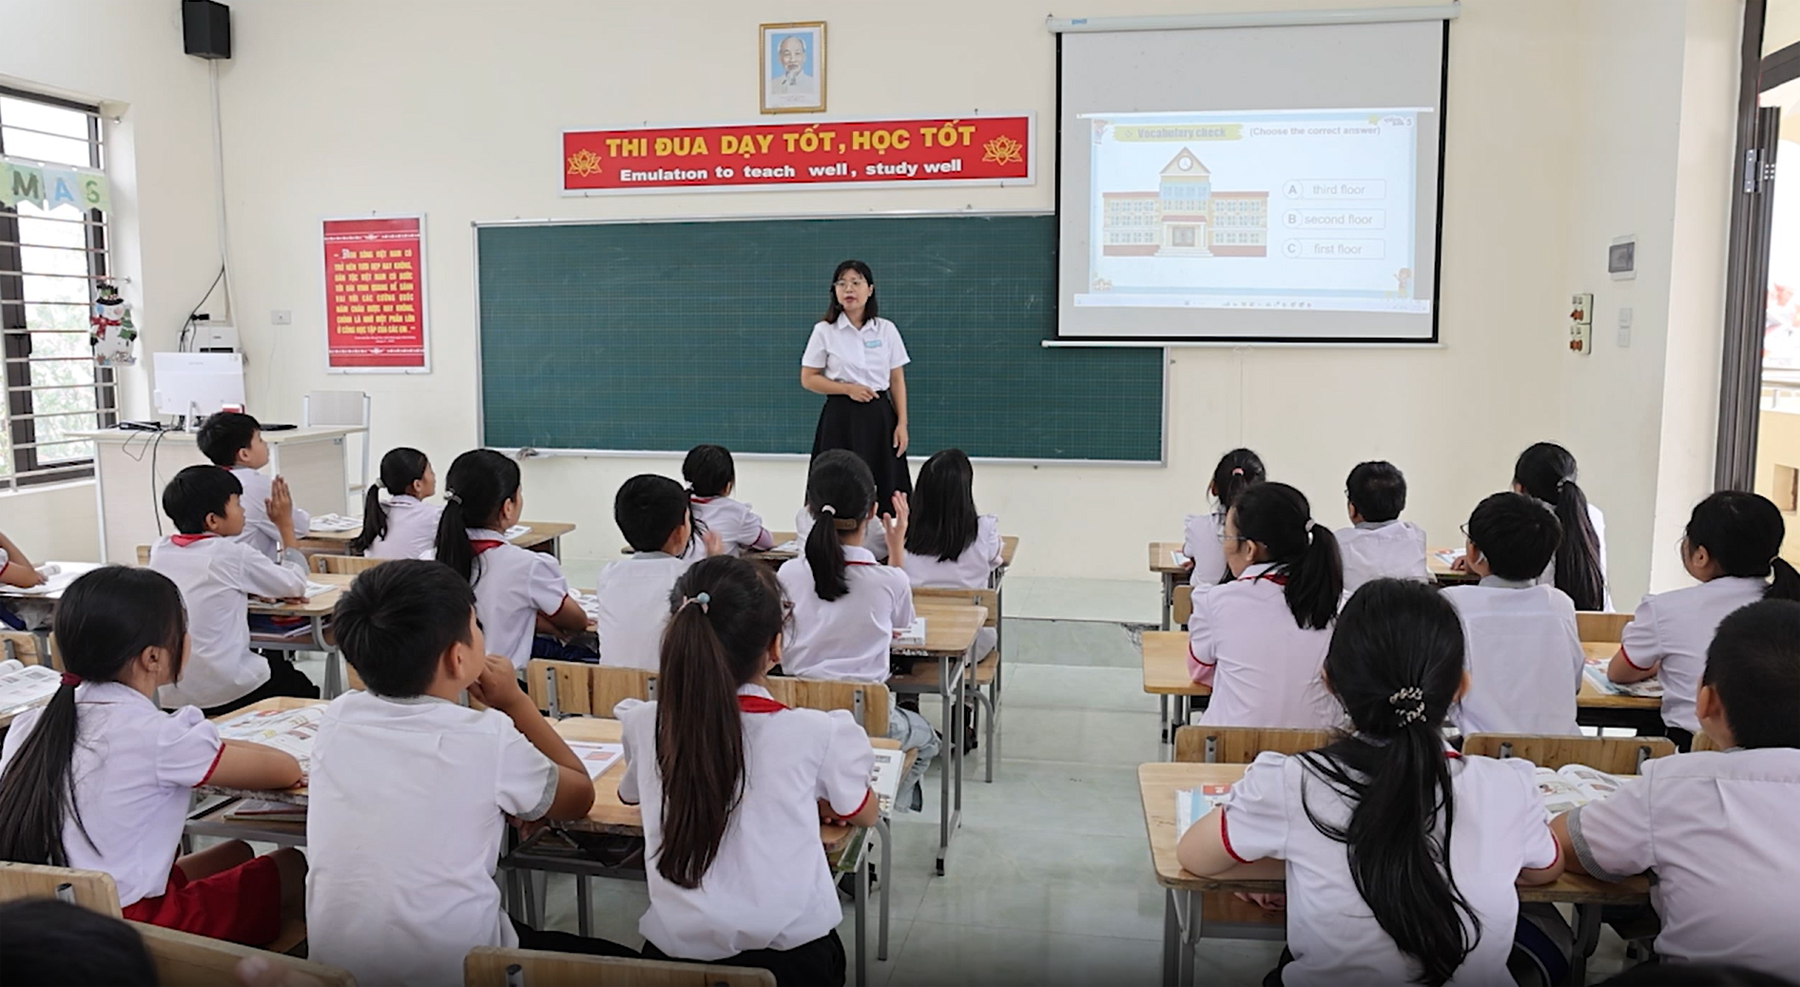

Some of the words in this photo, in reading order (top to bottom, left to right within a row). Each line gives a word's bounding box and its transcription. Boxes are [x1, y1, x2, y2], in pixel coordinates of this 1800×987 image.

[1406, 118, 1412, 126] 5
[1138, 128, 1194, 138] Vocabulary
[1196, 128, 1226, 137] check
[1250, 127, 1288, 137] (Choose
[1308, 127, 1341, 135] correct
[1343, 126, 1380, 136] answer)
[606, 138, 648, 157] THI
[654, 136, 708, 156] ĐUA
[720, 134, 774, 158] DẠY
[852, 130, 910, 154] HỌC
[920, 120, 976, 146] TỐT
[715, 166, 734, 178] to
[744, 165, 796, 178] teach
[866, 162, 918, 177] study
[924, 159, 961, 173] well
[1288, 184, 1297, 194] A
[1313, 184, 1337, 194] third
[1340, 184, 1365, 194] floor
[1288, 214, 1296, 224] B
[1304, 214, 1345, 224] second
[1348, 213, 1372, 224] floor
[1287, 243, 1296, 253] C
[1314, 243, 1335, 254] first
[1338, 243, 1362, 254] floor
